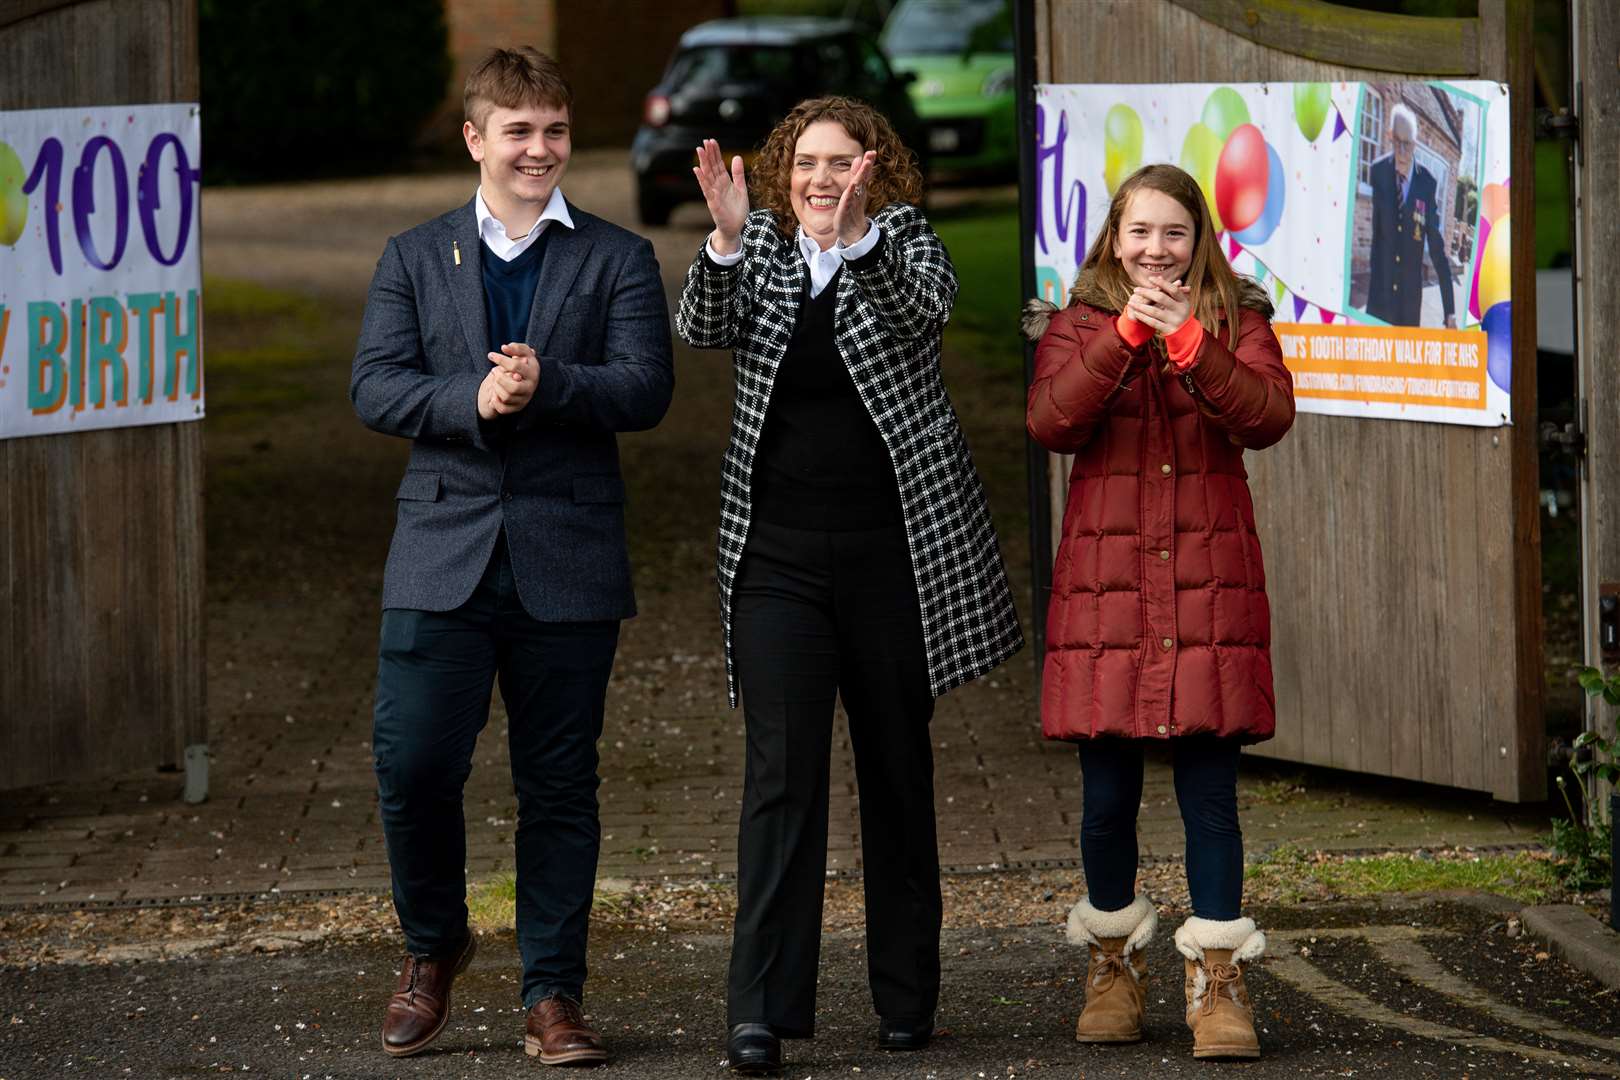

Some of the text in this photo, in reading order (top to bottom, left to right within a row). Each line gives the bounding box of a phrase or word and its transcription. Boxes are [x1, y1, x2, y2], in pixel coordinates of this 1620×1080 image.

[22, 133, 200, 276] 100
[27, 288, 200, 416] BIRTH
[1310, 335, 1344, 360] 100TH
[1344, 336, 1394, 363] BIRTHDAY
[1395, 338, 1423, 365] WALK
[1423, 341, 1442, 366] FOR
[1443, 342, 1458, 367] THE
[1458, 343, 1480, 369] NHS
